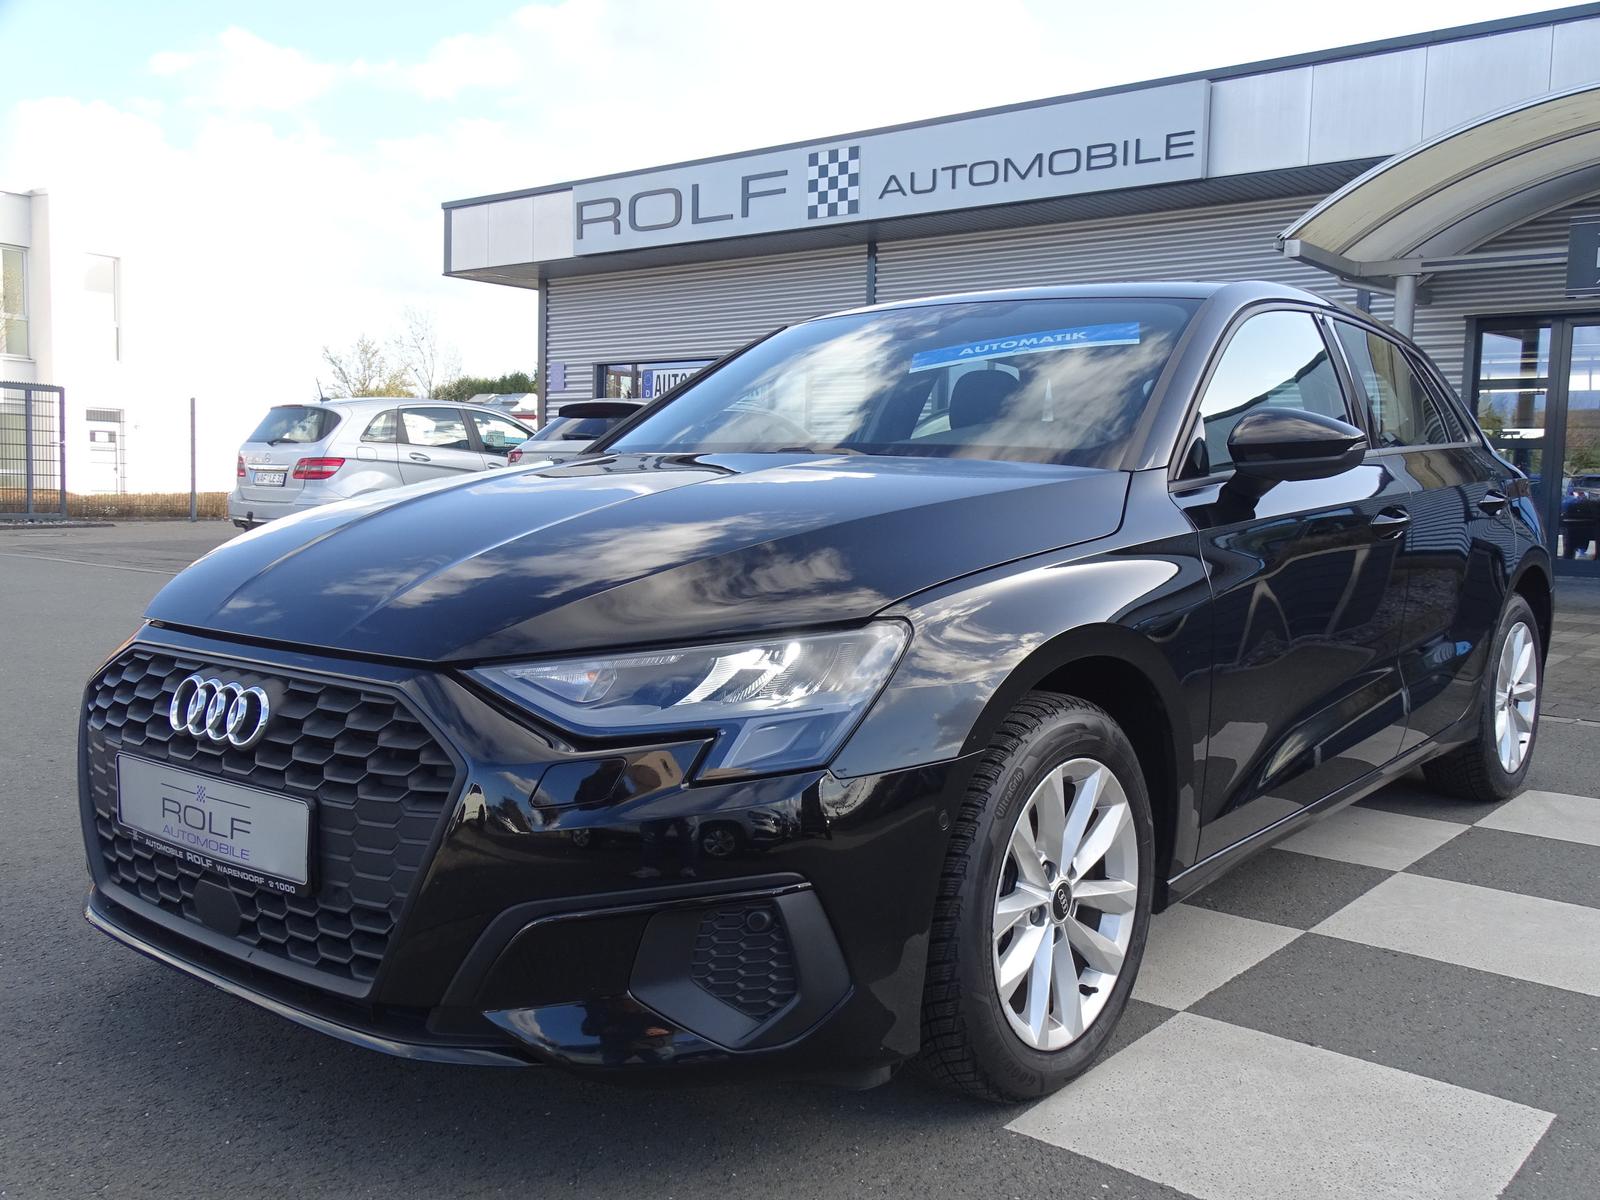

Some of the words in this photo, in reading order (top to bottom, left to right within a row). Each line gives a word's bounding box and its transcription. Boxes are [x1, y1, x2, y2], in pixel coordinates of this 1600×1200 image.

[575, 169, 788, 241] ROLF
[878, 130, 1196, 200] AUTOMOBILE
[958, 331, 1088, 356] AUTOMATIK
[645, 390, 651, 398] D
[995, 771, 1024, 818] UltraGrip
[162, 797, 252, 840] ROLF
[145, 838, 184, 859] AUTOMOBILE
[186, 851, 213, 868] ROLF
[215, 864, 265, 885] WARENDORF
[162, 824, 251, 861] AUTOMOBILE
